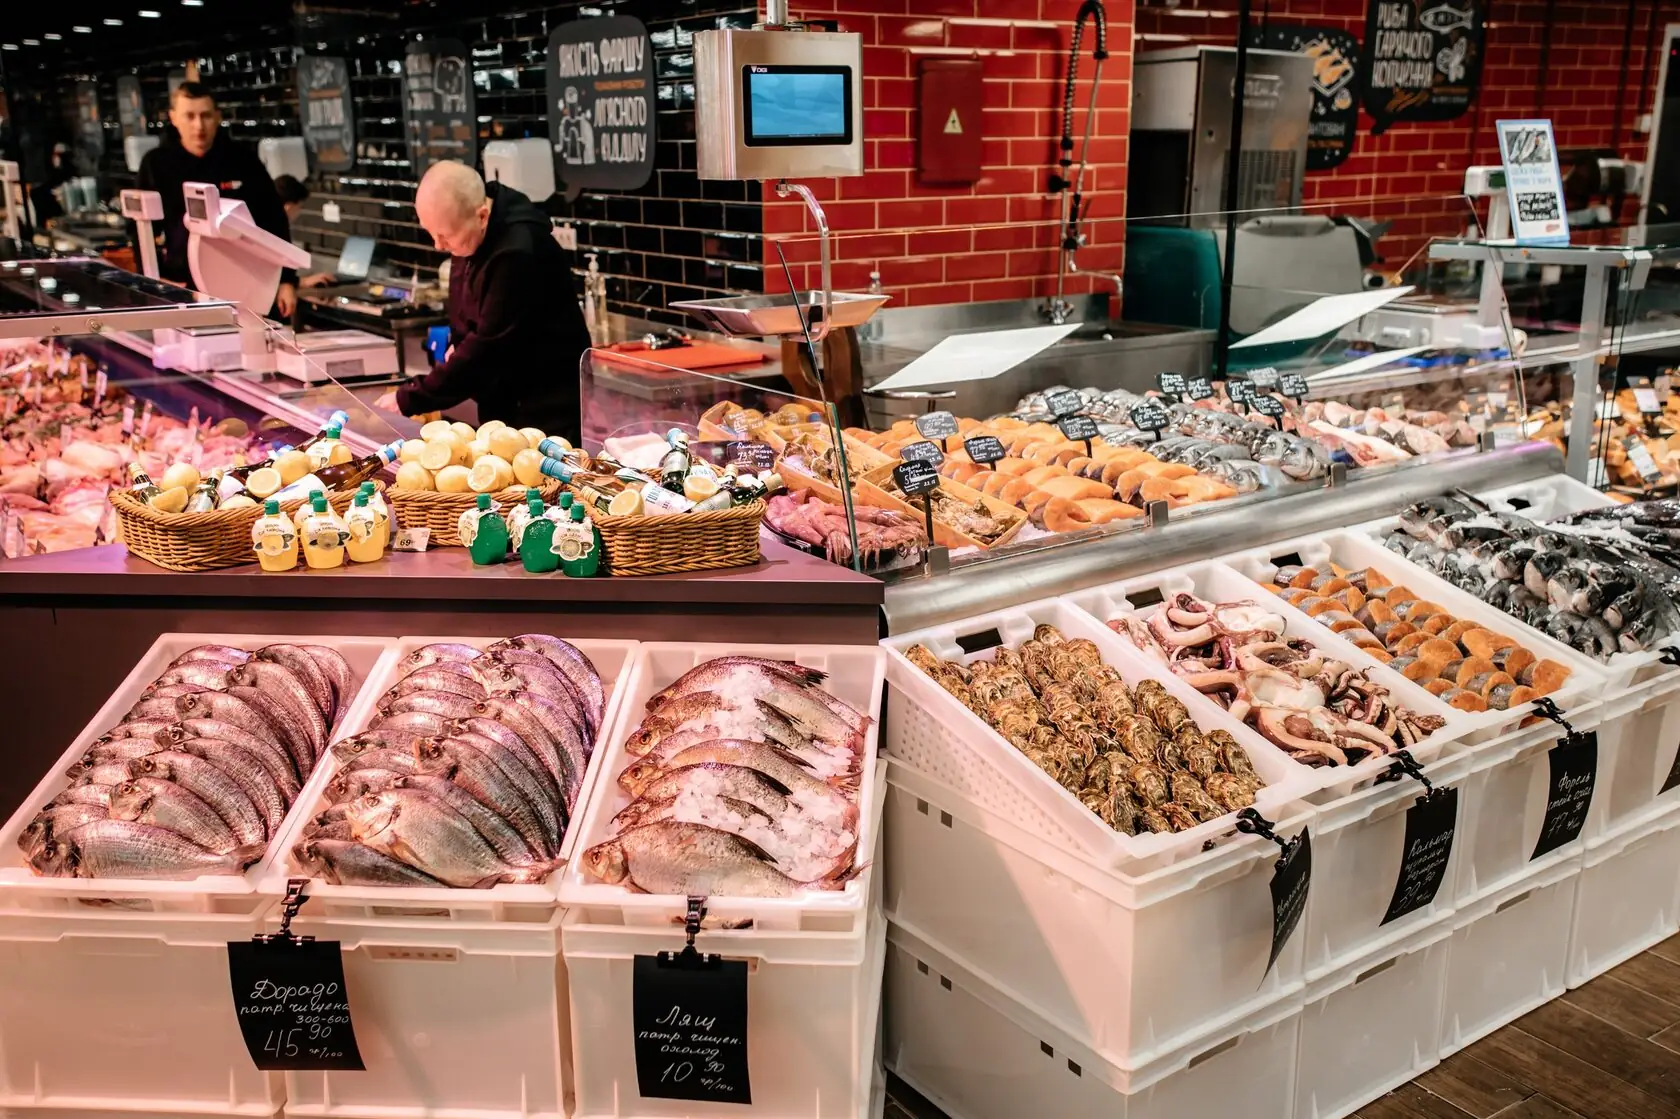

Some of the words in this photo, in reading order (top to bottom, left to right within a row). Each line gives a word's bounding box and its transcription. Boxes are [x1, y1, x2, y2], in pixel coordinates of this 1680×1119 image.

[1377, 3, 1409, 28] РИБА
[559, 42, 599, 77] ЯКІСТЬ
[600, 36, 645, 73] ФАРШУ
[1375, 30, 1433, 59] ГАРЯЧОГО
[1371, 60, 1434, 88] КОПЧЕННЯ
[601, 132, 647, 163] ВІДДІЛУ
[1408, 829, 1454, 860] Кальмар
[250, 979, 338, 1004] Дорадо
[295, 1015, 349, 1024] 300-600
[656, 1005, 716, 1031] Лящ
[264, 1029, 303, 1058] 45
[308, 1023, 332, 1040] 90
[661, 1062, 693, 1083] 10
[704, 1060, 725, 1073] 90
